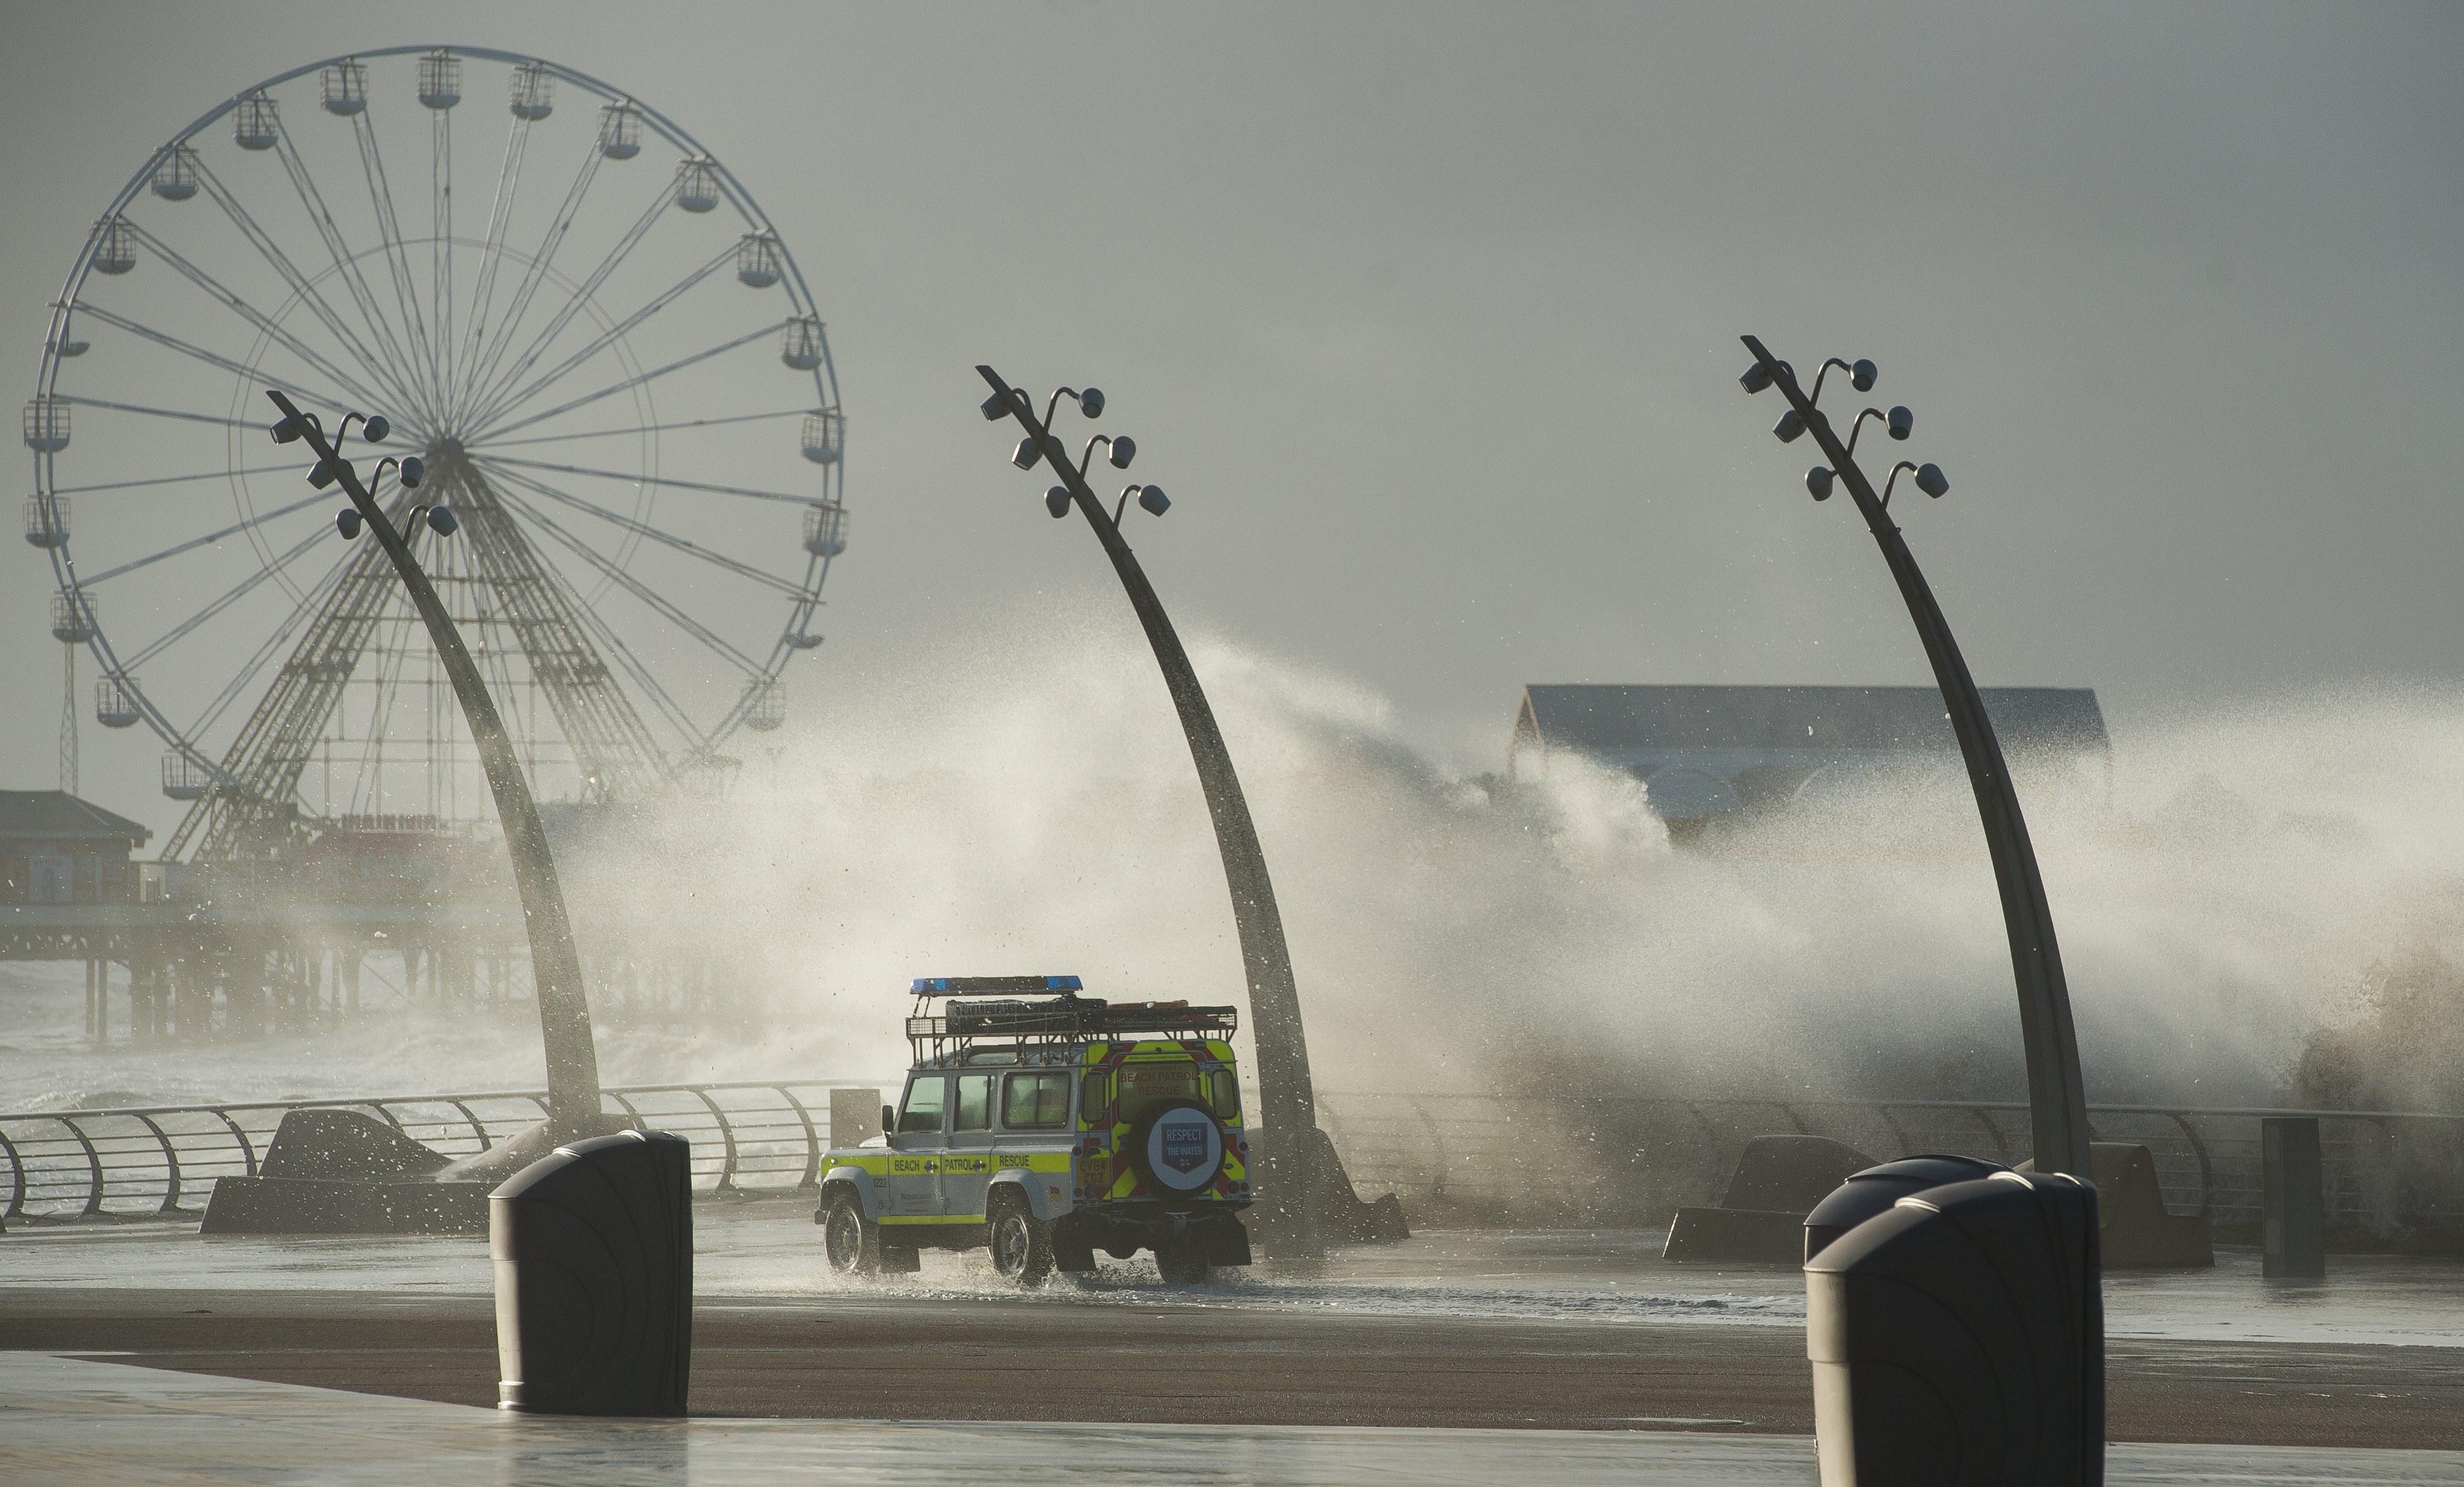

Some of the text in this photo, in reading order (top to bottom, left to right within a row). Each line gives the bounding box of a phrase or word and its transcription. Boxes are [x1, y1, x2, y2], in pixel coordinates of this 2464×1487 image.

[1120, 1071, 1198, 1082] BEACH PATROL
[1138, 1085, 1180, 1096] RESCUE
[1166, 1129, 1202, 1141] RESPECT
[1168, 1146, 1202, 1156] THE WATER
[894, 1155, 1029, 1171] BEACH PATROL RESCUE
